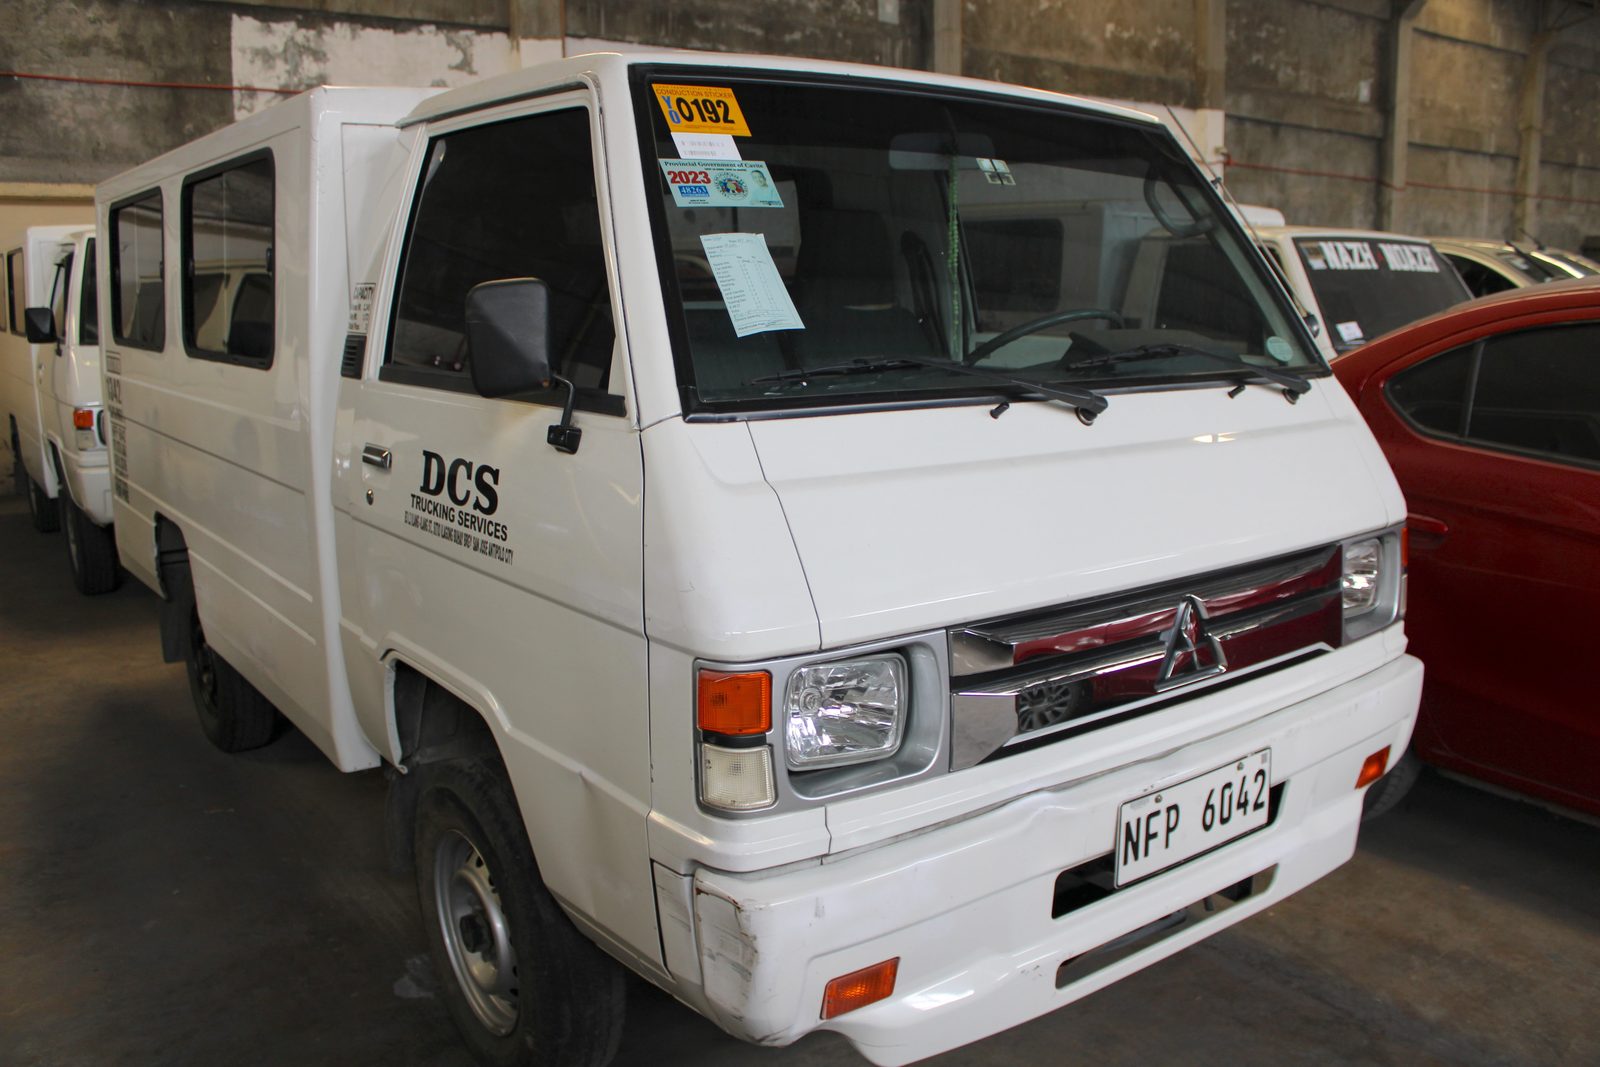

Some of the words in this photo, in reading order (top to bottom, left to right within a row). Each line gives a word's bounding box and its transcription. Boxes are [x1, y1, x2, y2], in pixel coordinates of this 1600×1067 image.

[656, 88, 704, 97] CONDUCTION
[704, 90, 734, 99] STICKER
[676, 97, 735, 124] 0192
[667, 171, 711, 184] 2023
[680, 186, 707, 196] 48263
[420, 450, 500, 516] DCS
[411, 493, 455, 523] TRUCKING
[457, 510, 508, 542] SERVICES
[1122, 803, 1180, 866] NFP
[1202, 768, 1266, 832] 6042
